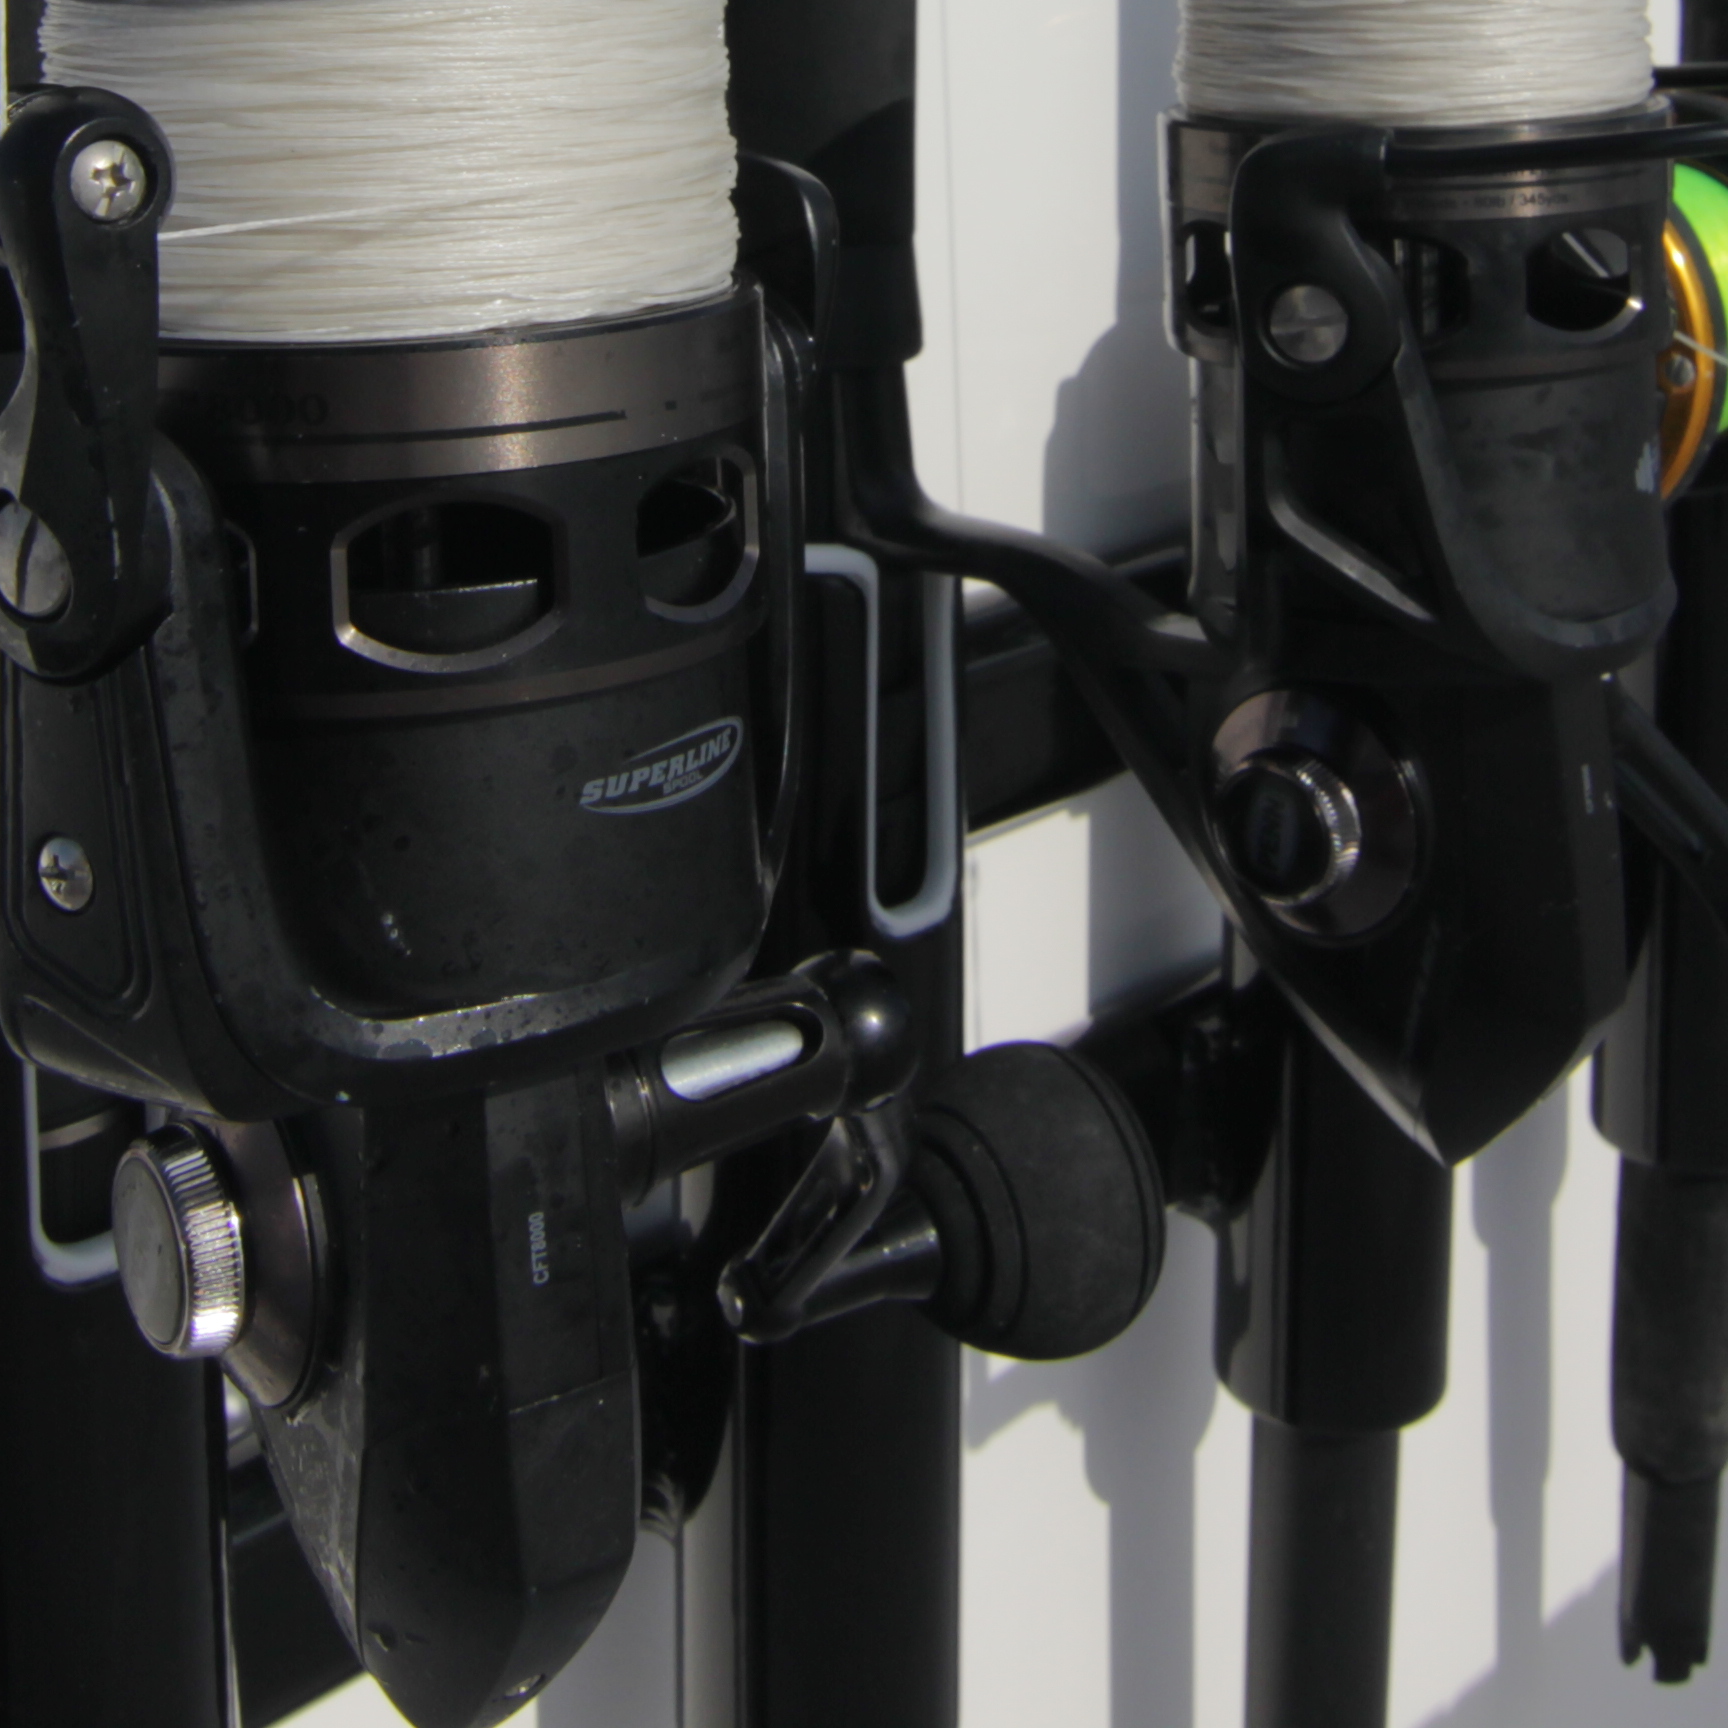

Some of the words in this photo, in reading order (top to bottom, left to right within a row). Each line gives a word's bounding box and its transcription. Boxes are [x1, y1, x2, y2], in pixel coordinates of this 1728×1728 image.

[579, 727, 732, 805] SUPERLINE
[663, 770, 703, 796] SPOOL
[527, 1211, 550, 1284] CFT8000
